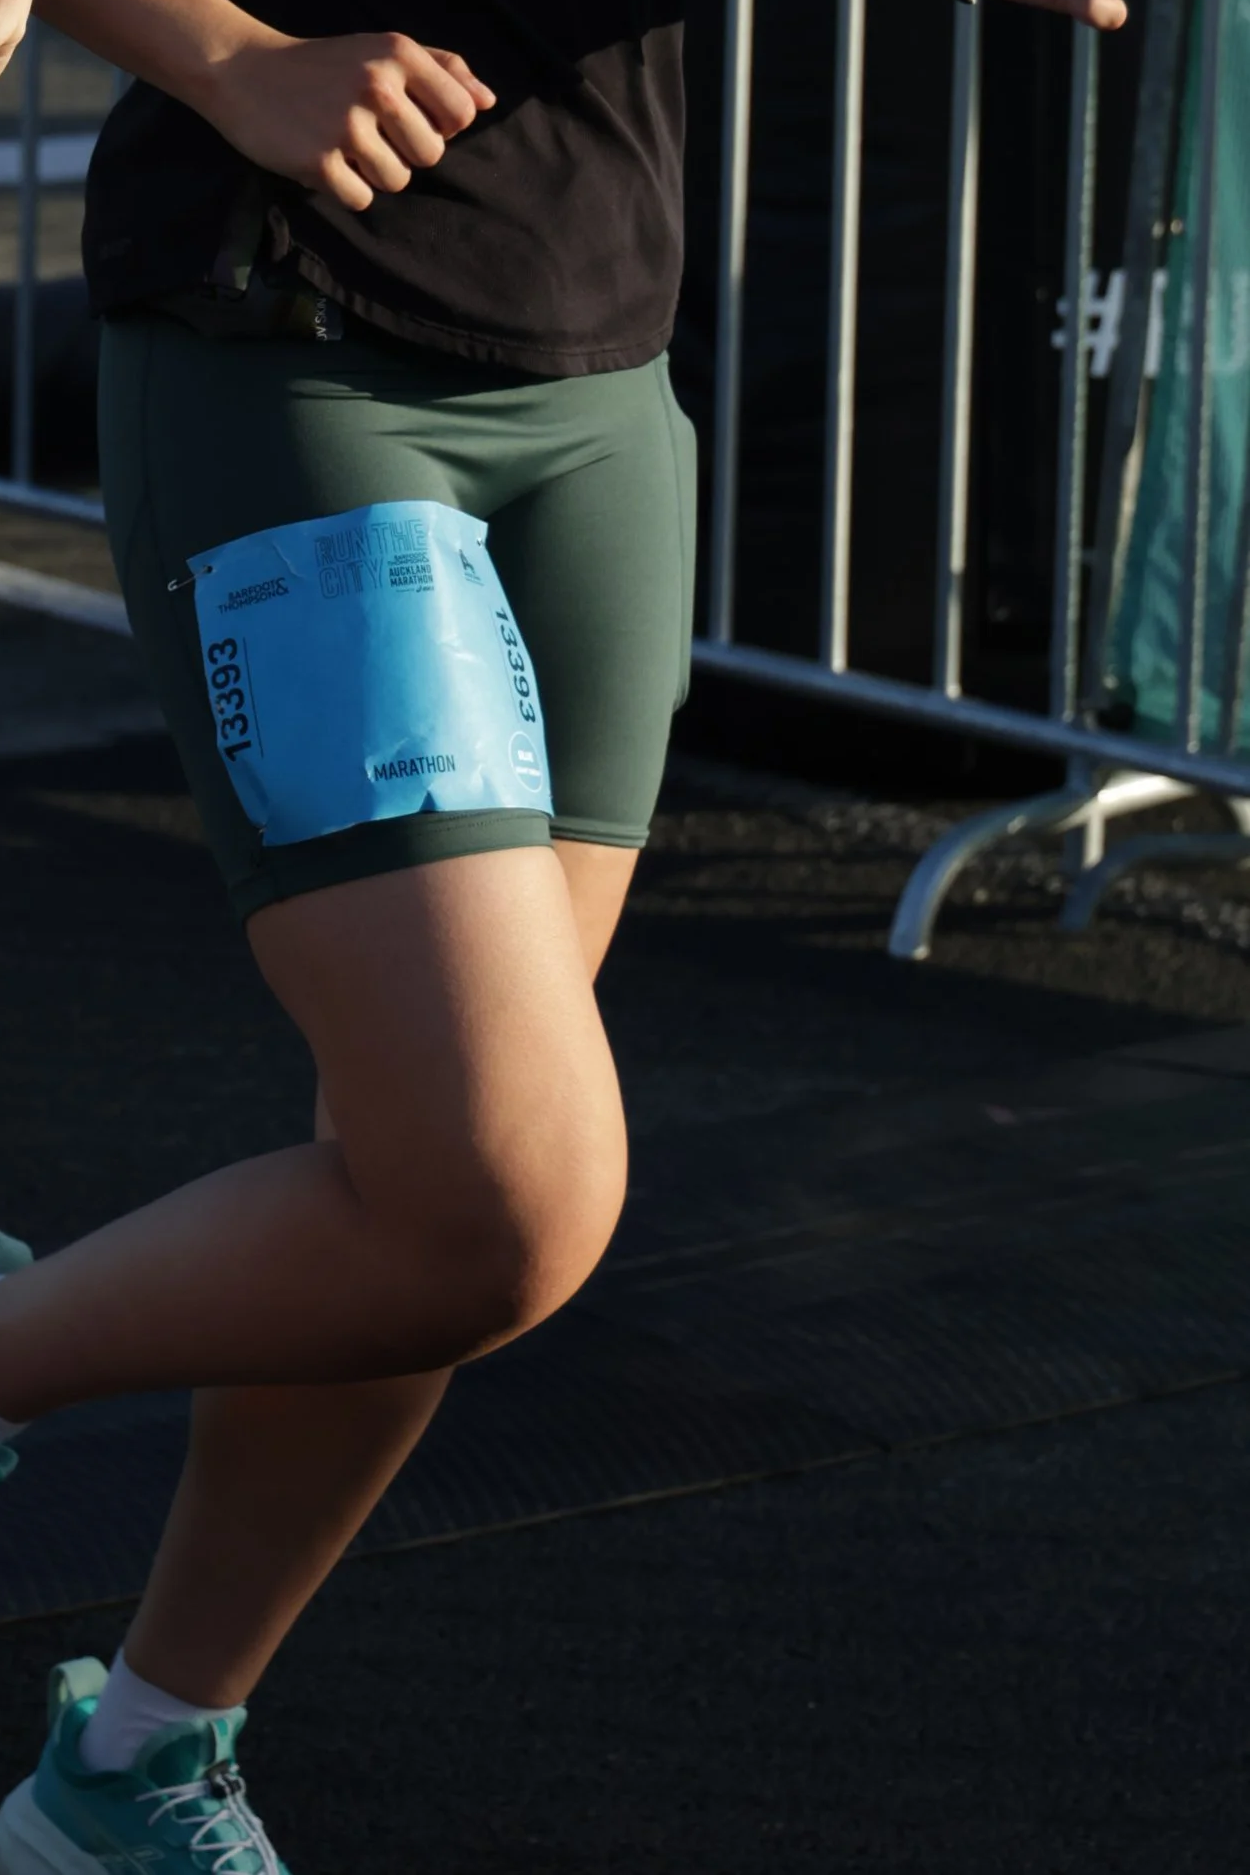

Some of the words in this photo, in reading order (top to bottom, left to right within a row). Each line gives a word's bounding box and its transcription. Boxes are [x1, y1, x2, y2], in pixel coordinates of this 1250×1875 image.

[314, 525, 371, 568] RUN
[371, 519, 428, 554] THE
[319, 557, 384, 600] CITY
[388, 564, 432, 578] AUCKLAND
[390, 574, 434, 588] MARATHON
[496, 606, 537, 724] 13393
[207, 637, 252, 763] 13393
[372, 754, 456, 783] MARATHON
